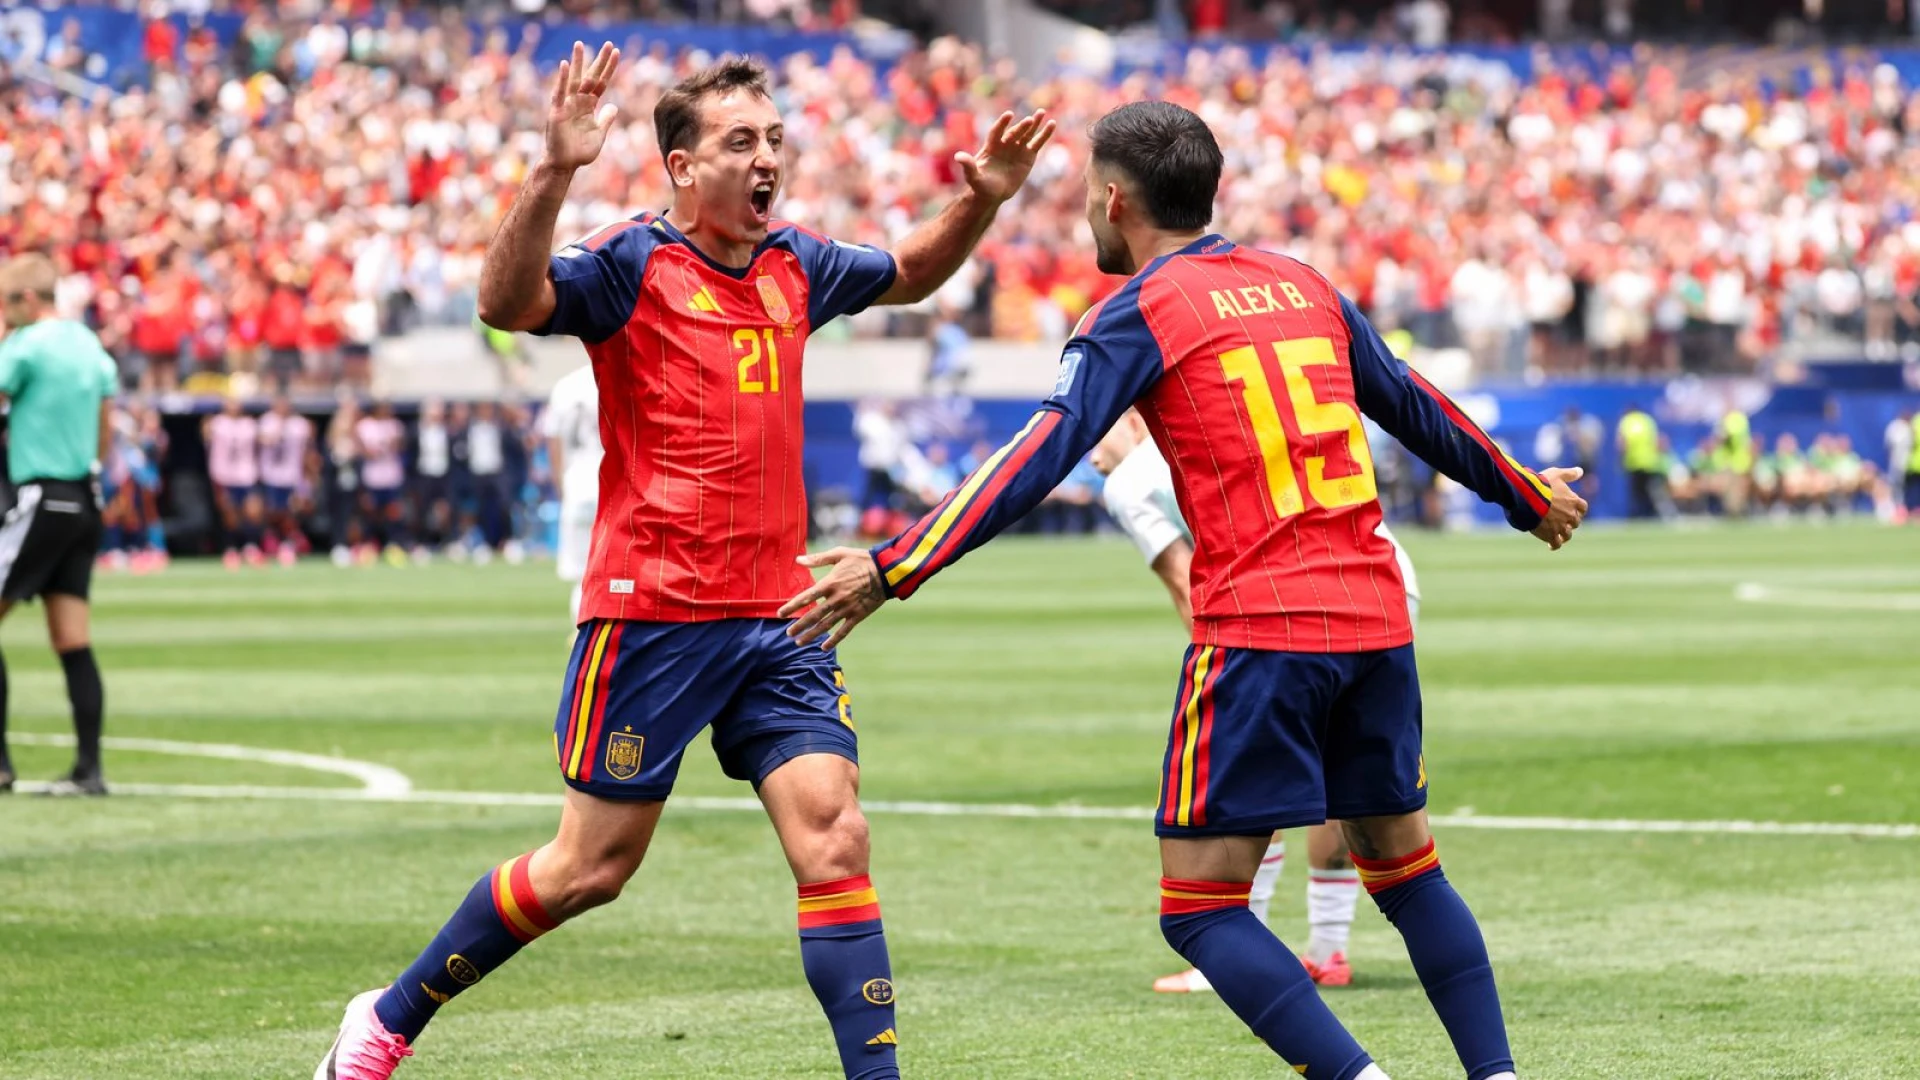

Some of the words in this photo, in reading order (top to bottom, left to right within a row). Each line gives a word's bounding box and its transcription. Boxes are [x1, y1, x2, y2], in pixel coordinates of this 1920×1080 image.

[1208, 284, 1286, 320] ALEX
[1278, 281, 1315, 309] B.
[732, 328, 779, 393] 21
[1218, 336, 1378, 519] 15
